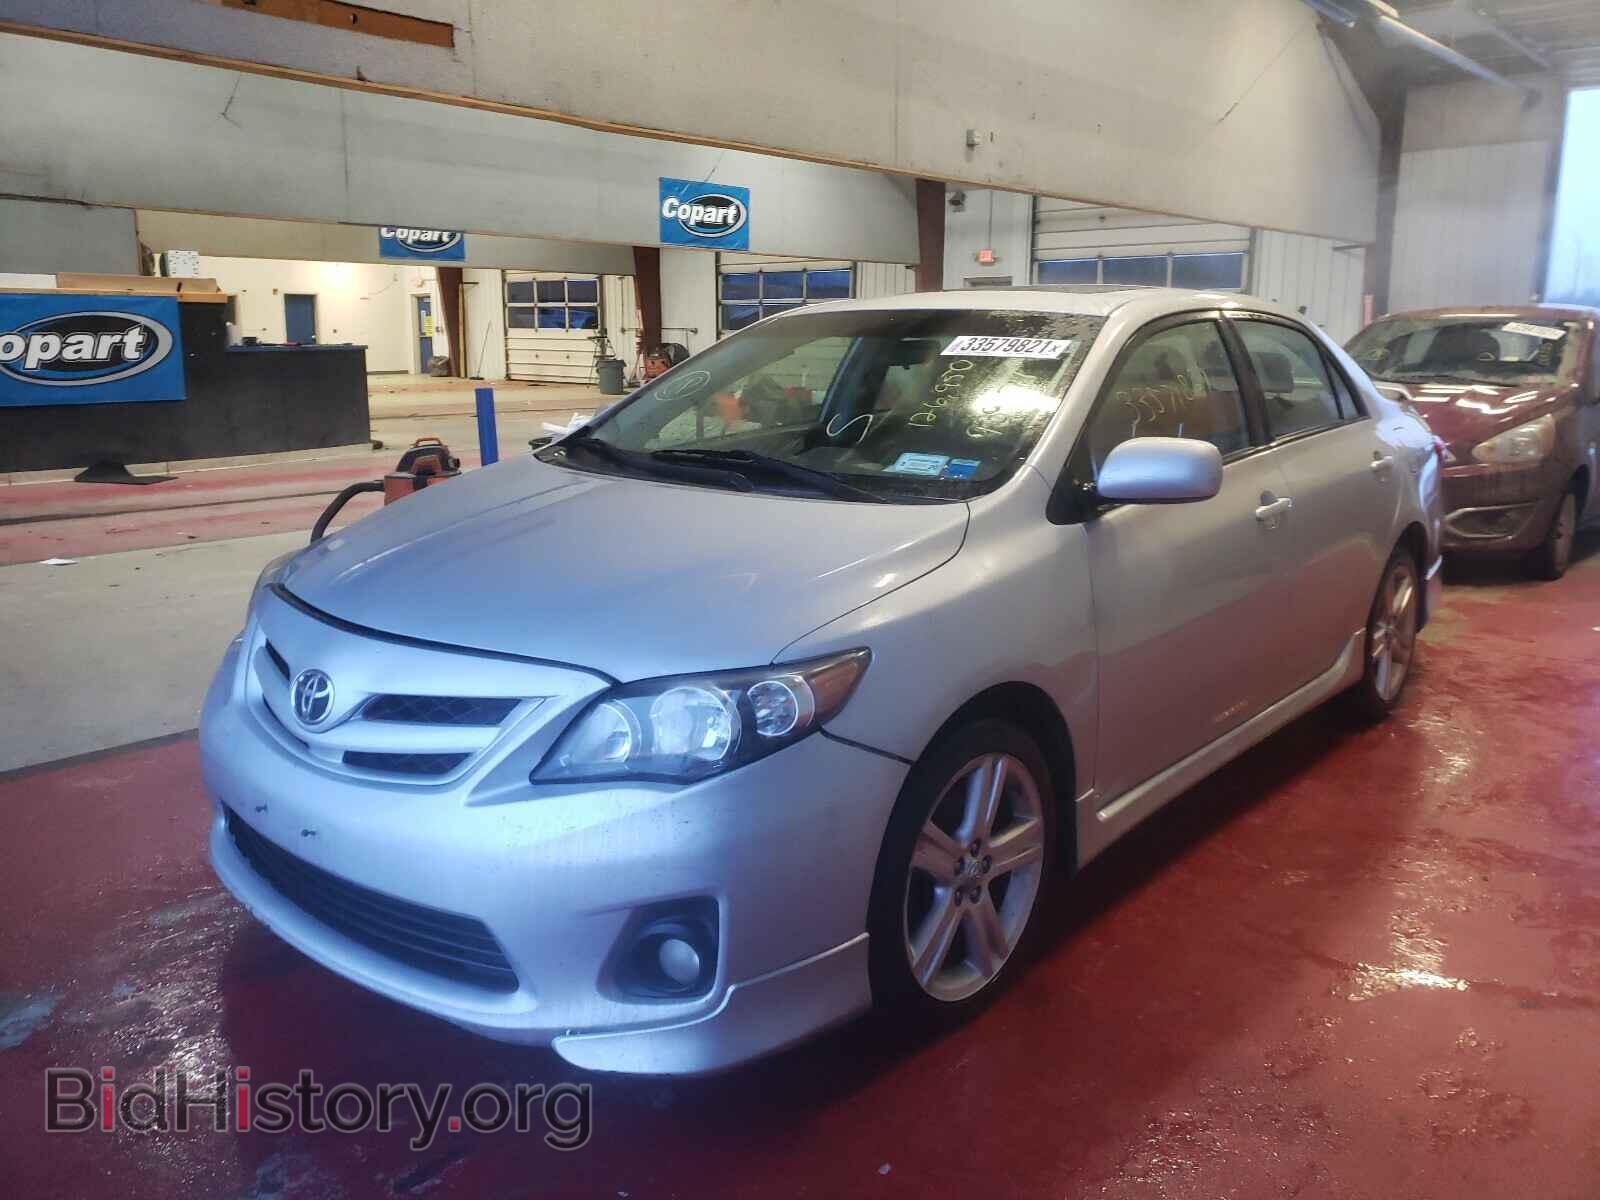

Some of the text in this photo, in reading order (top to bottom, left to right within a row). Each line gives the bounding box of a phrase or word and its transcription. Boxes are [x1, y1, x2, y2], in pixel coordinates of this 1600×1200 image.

[662, 197, 737, 226] Copart
[0, 325, 145, 370] opart
[960, 337, 1053, 354] 33579821
